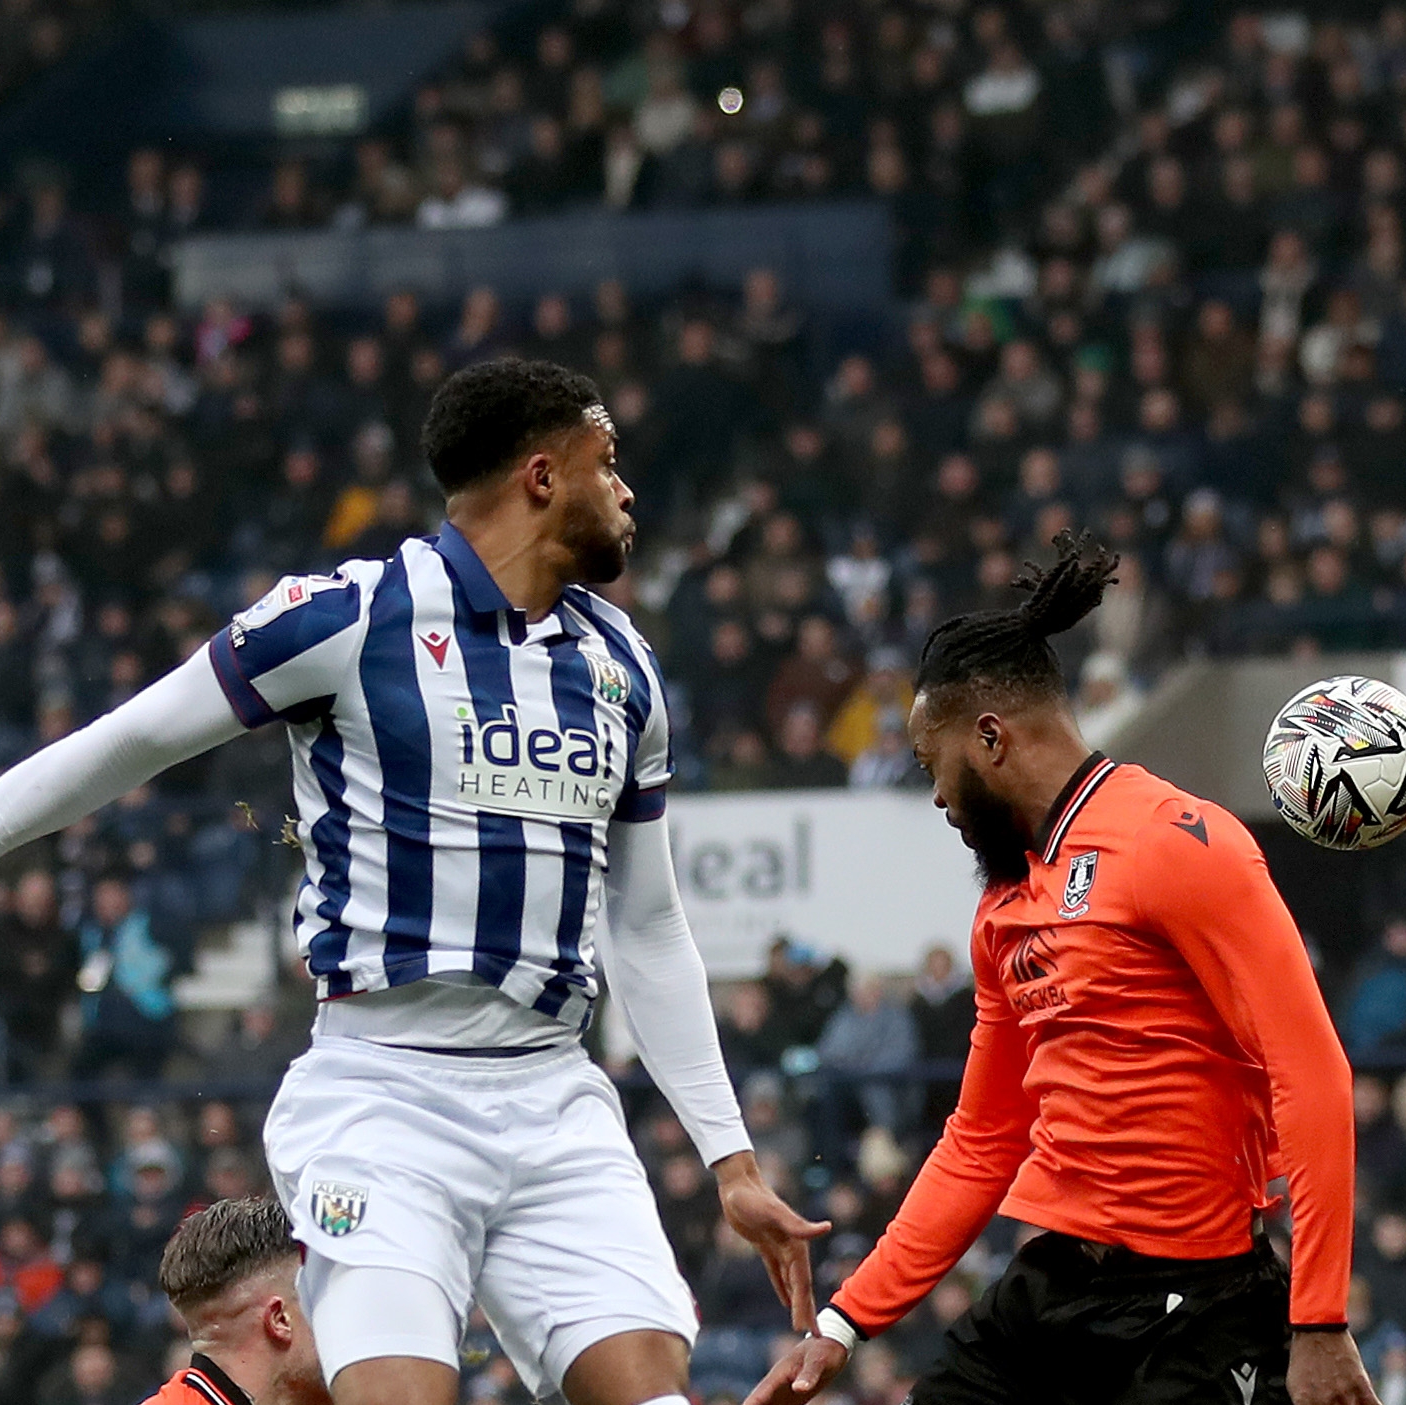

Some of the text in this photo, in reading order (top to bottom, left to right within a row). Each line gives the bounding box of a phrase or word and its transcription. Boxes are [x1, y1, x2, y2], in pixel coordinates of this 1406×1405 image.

[456, 705, 614, 781] ideal
[459, 771, 611, 809] HEATING
[669, 816, 814, 899] eal
